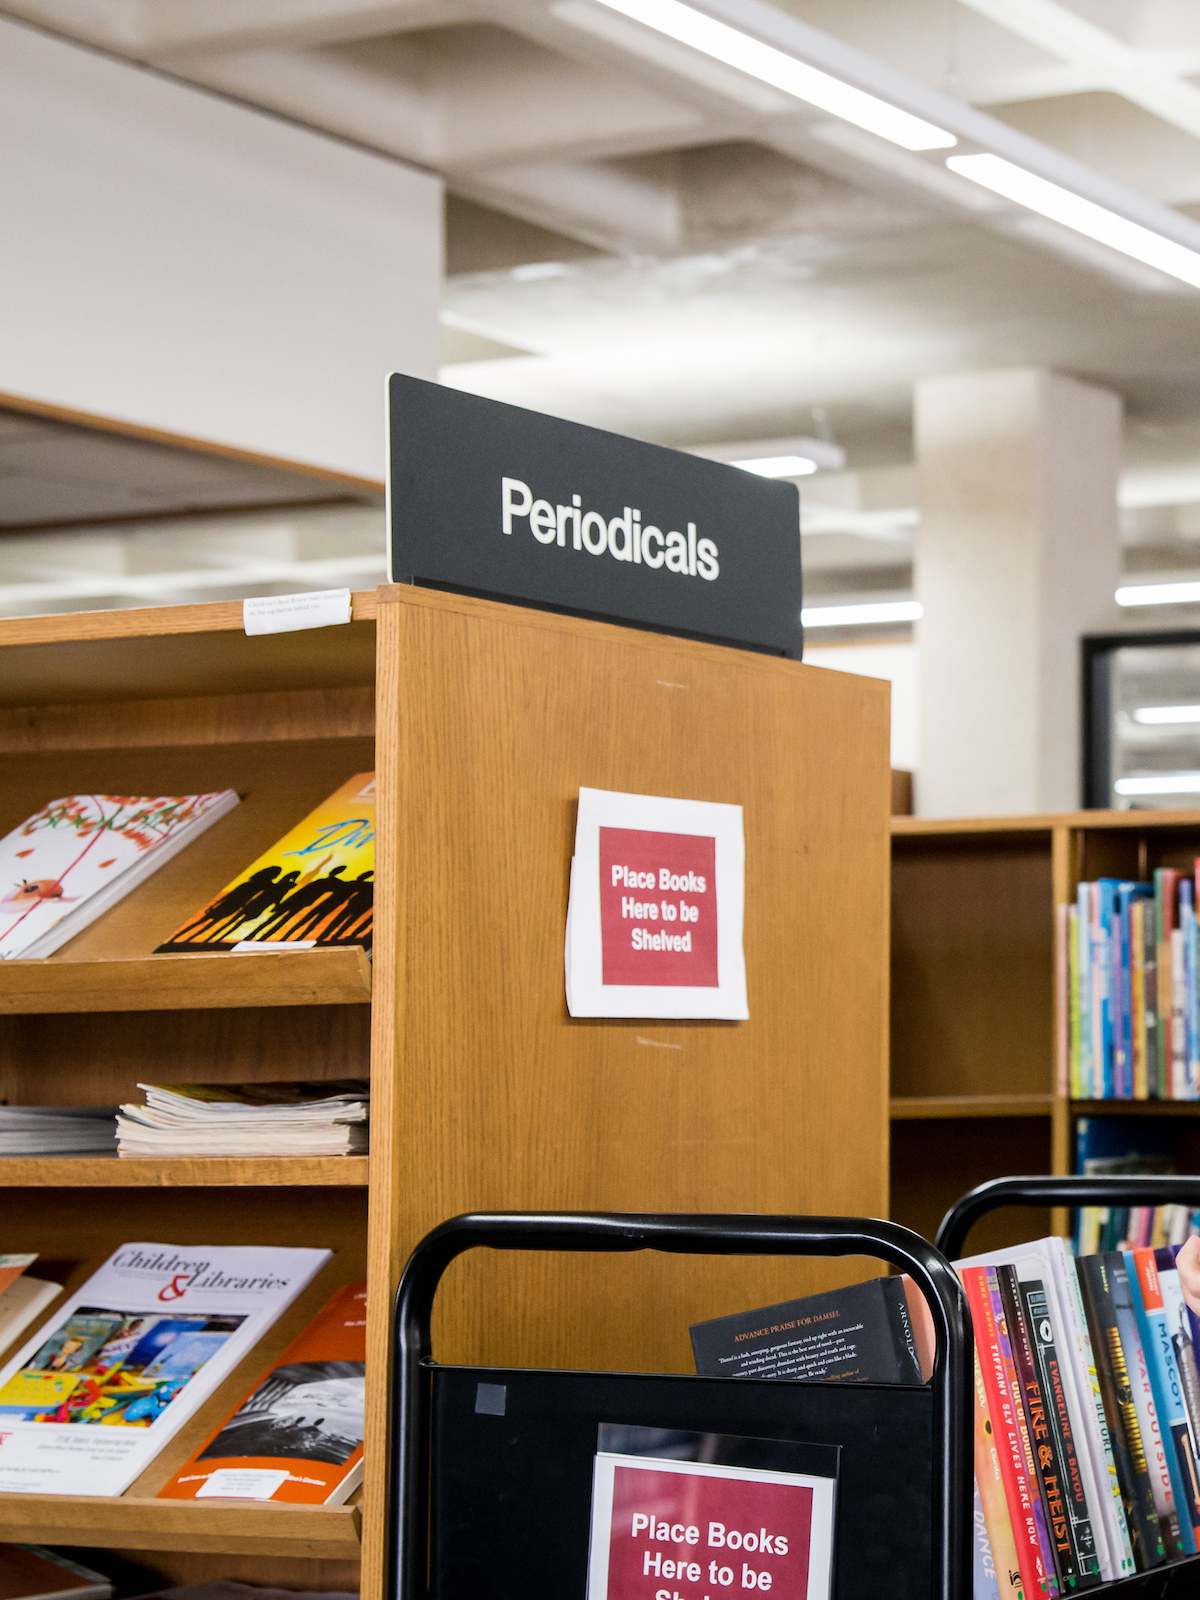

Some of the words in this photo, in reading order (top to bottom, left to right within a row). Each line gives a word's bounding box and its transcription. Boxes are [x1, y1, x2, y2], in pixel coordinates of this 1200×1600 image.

[501, 477, 719, 582] Periodicals
[611, 864, 655, 889] Place
[659, 868, 707, 894] Books
[621, 896, 659, 920] Here
[661, 900, 677, 921] to
[680, 901, 698, 922] be
[631, 928, 692, 952] Shelved
[112, 1250, 210, 1273] Children
[1100, 1265, 1109, 1293] Healy
[158, 1275, 191, 1302] &
[186, 1271, 290, 1289] Libraries
[978, 1275, 987, 1298] DANA
[985, 1311, 995, 1338] DAVIS
[733, 1327, 770, 1342] ADVANCE
[770, 1321, 796, 1333] PRAISE
[796, 1317, 812, 1326] FOR
[812, 1310, 840, 1322] DAMSEL
[898, 1302, 915, 1356] ARNOLD
[1009, 1278, 1020, 1308] SARAH
[1017, 1311, 1025, 1335] BETH
[1022, 1338, 1032, 1367] DURST
[1158, 1322, 1183, 1409] MASCOT
[1025, 1381, 1049, 1440] FIRE
[1049, 1360, 1071, 1439] EVANGELINE
[1087, 1365, 1102, 1397] 12
[1095, 1403, 1112, 1455] BEFORE
[991, 1344, 1007, 1396] TIFFANY
[1002, 1404, 1014, 1425] SLY
[1008, 1432, 1023, 1470] LIVES
[1017, 1476, 1031, 1510] HERE
[1026, 1517, 1038, 1546] NOW
[1137, 1348, 1151, 1393] WAR
[1147, 1401, 1174, 1503] OUTSIDE
[1038, 1444, 1053, 1470] &
[1067, 1457, 1084, 1502] BAYOU
[631, 1512, 700, 1545] Place
[707, 1522, 789, 1556] Books
[1044, 1475, 1072, 1556] HEIST
[643, 1550, 701, 1582] Here
[708, 1560, 734, 1586] to
[741, 1563, 773, 1591] be
